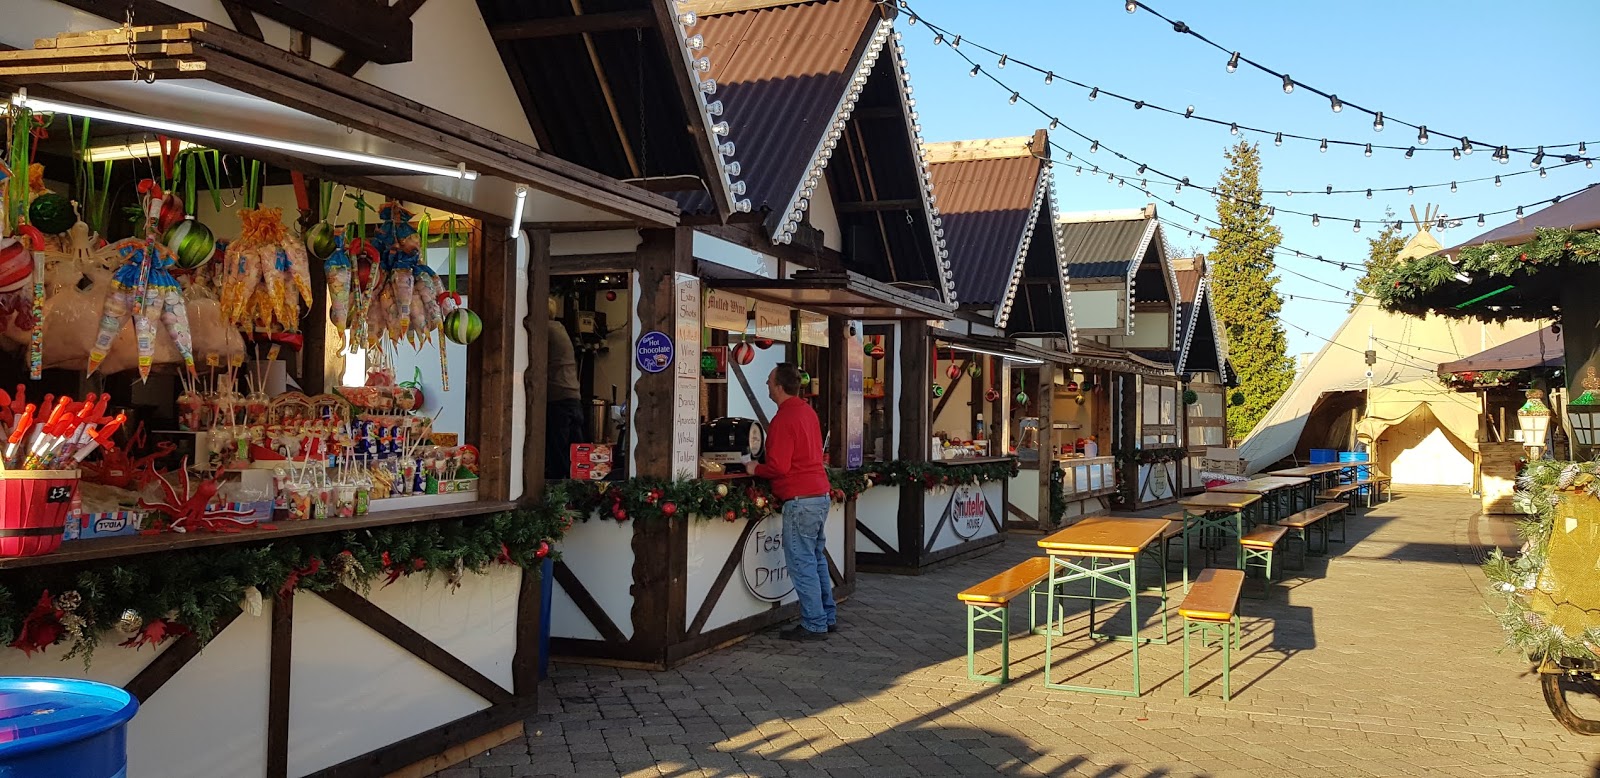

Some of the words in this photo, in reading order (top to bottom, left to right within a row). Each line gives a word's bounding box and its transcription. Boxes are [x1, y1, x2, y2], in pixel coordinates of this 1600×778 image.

[680, 288, 696, 302] Extra
[680, 304, 697, 318] Shots
[707, 296, 729, 312] Mulled
[730, 299, 746, 315] Wine
[639, 346, 671, 355] Chocolate
[681, 344, 695, 357] Wine
[677, 361, 688, 375] £2
[678, 394, 696, 411] Brandy
[960, 487, 969, 498] THE
[99, 521, 122, 529] VIDAL
[966, 518, 980, 529] HOUSE
[756, 530, 784, 555] Fest
[755, 560, 789, 589] Drin
